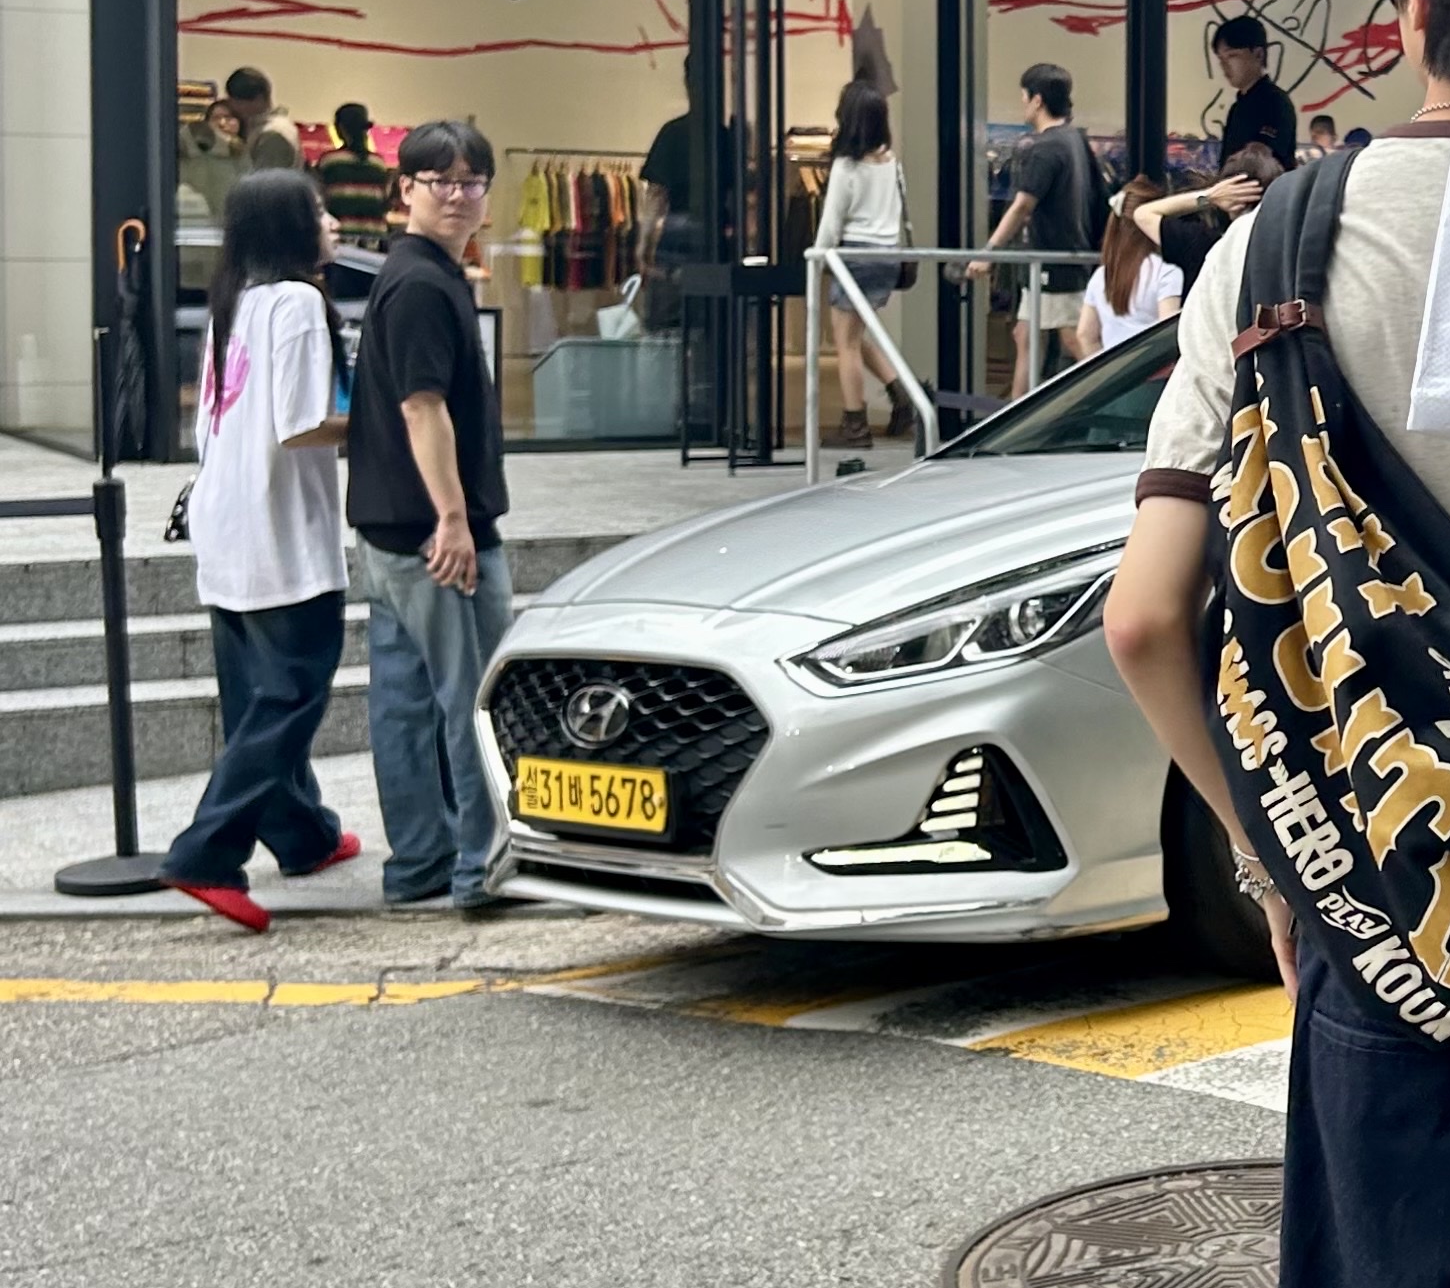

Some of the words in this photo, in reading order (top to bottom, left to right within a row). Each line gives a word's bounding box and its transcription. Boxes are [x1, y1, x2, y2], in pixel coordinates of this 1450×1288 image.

[590, 774, 657, 821] 5678
[1260, 770, 1354, 893] HERO
[1316, 888, 1392, 940] PLAY
